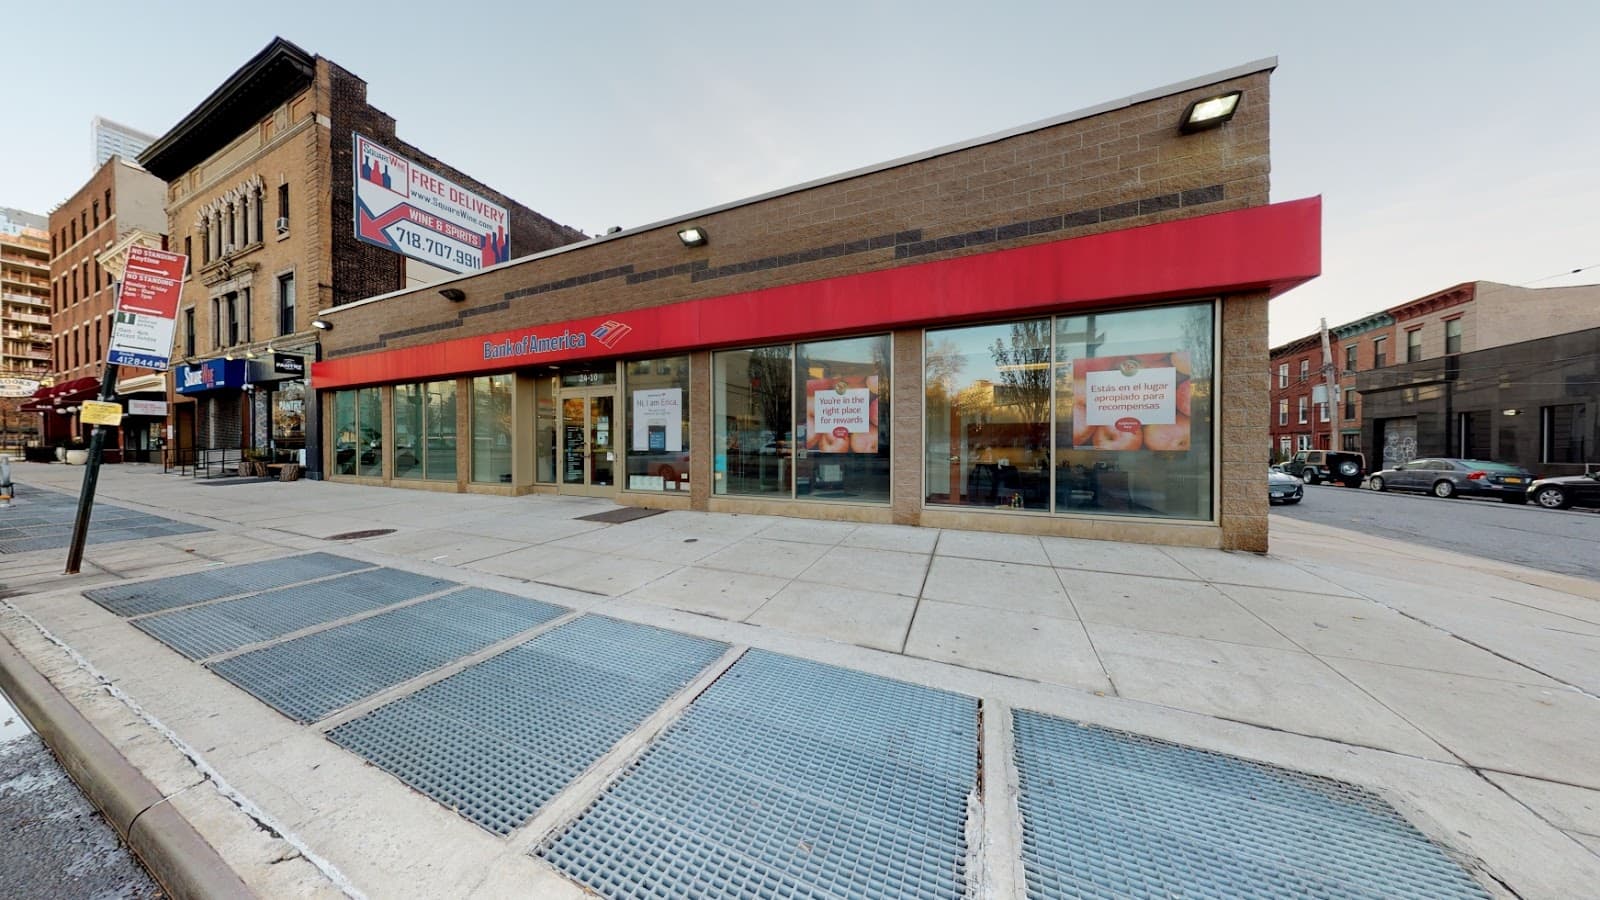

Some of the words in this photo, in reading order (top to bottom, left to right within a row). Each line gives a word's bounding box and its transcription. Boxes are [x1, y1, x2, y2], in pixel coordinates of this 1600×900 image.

[411, 168, 445, 197] FREE
[449, 187, 505, 224] DELIVERY
[409, 208, 434, 228] WINE
[436, 222, 443, 231] &
[445, 224, 478, 246] SPIRITS
[396, 226, 481, 270] 718.707.9911
[131, 247, 143, 255] NO
[143, 250, 178, 262] STANDING
[139, 275, 174, 287] STANDING
[483, 338, 514, 360] Bank
[515, 335, 528, 356] of
[529, 329, 586, 354] America
[116, 355, 153, 368] 412844
[1091, 383, 1116, 393] Estás
[1132, 382, 1142, 391] el
[1144, 381, 1168, 392] lugar
[819, 396, 841, 405] You're
[843, 396, 850, 404] in
[852, 395, 864, 404] the
[1094, 392, 1140, 403] apropiado
[1142, 393, 1165, 402] para
[822, 406, 840, 417] right
[841, 406, 861, 416] place
[1098, 403, 1160, 412] recompensas
[820, 416, 833, 424] for
[834, 416, 863, 424] rewards
